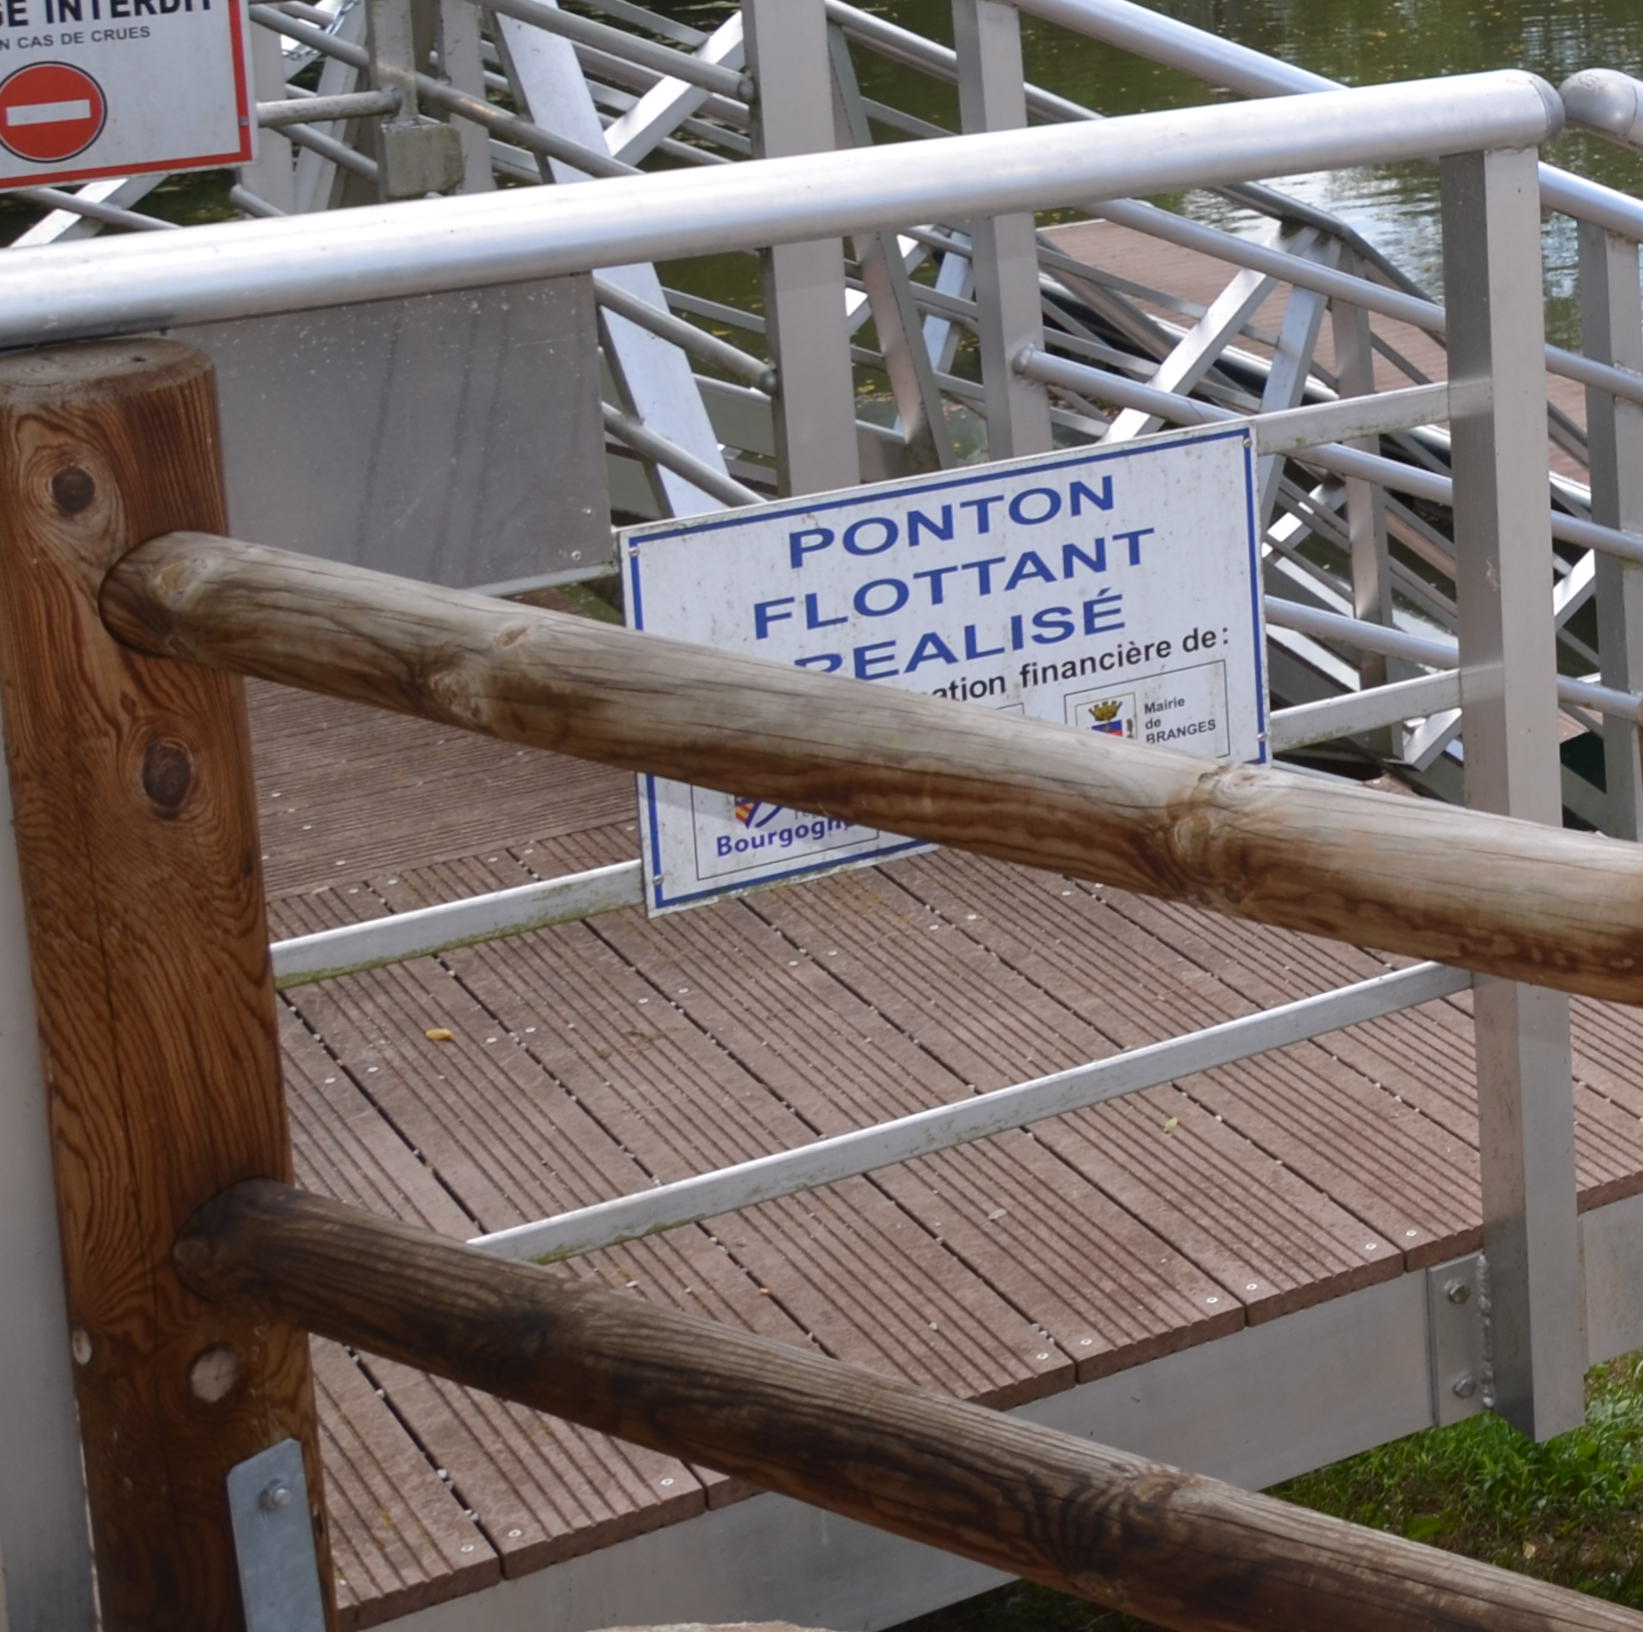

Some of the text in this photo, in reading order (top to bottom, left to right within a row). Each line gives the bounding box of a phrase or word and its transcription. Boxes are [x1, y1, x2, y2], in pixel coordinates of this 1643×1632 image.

[17, 35, 54, 49] CAS
[61, 32, 85, 45] DE
[91, 26, 151, 42] CRUES
[789, 475, 1114, 569] PONTON
[753, 528, 1156, 640] FLOTTANT
[1020, 639, 1172, 688] financière
[1144, 696, 1185, 714] Mairie
[1145, 718, 1161, 730] de
[1146, 719, 1217, 745] BRANGES
